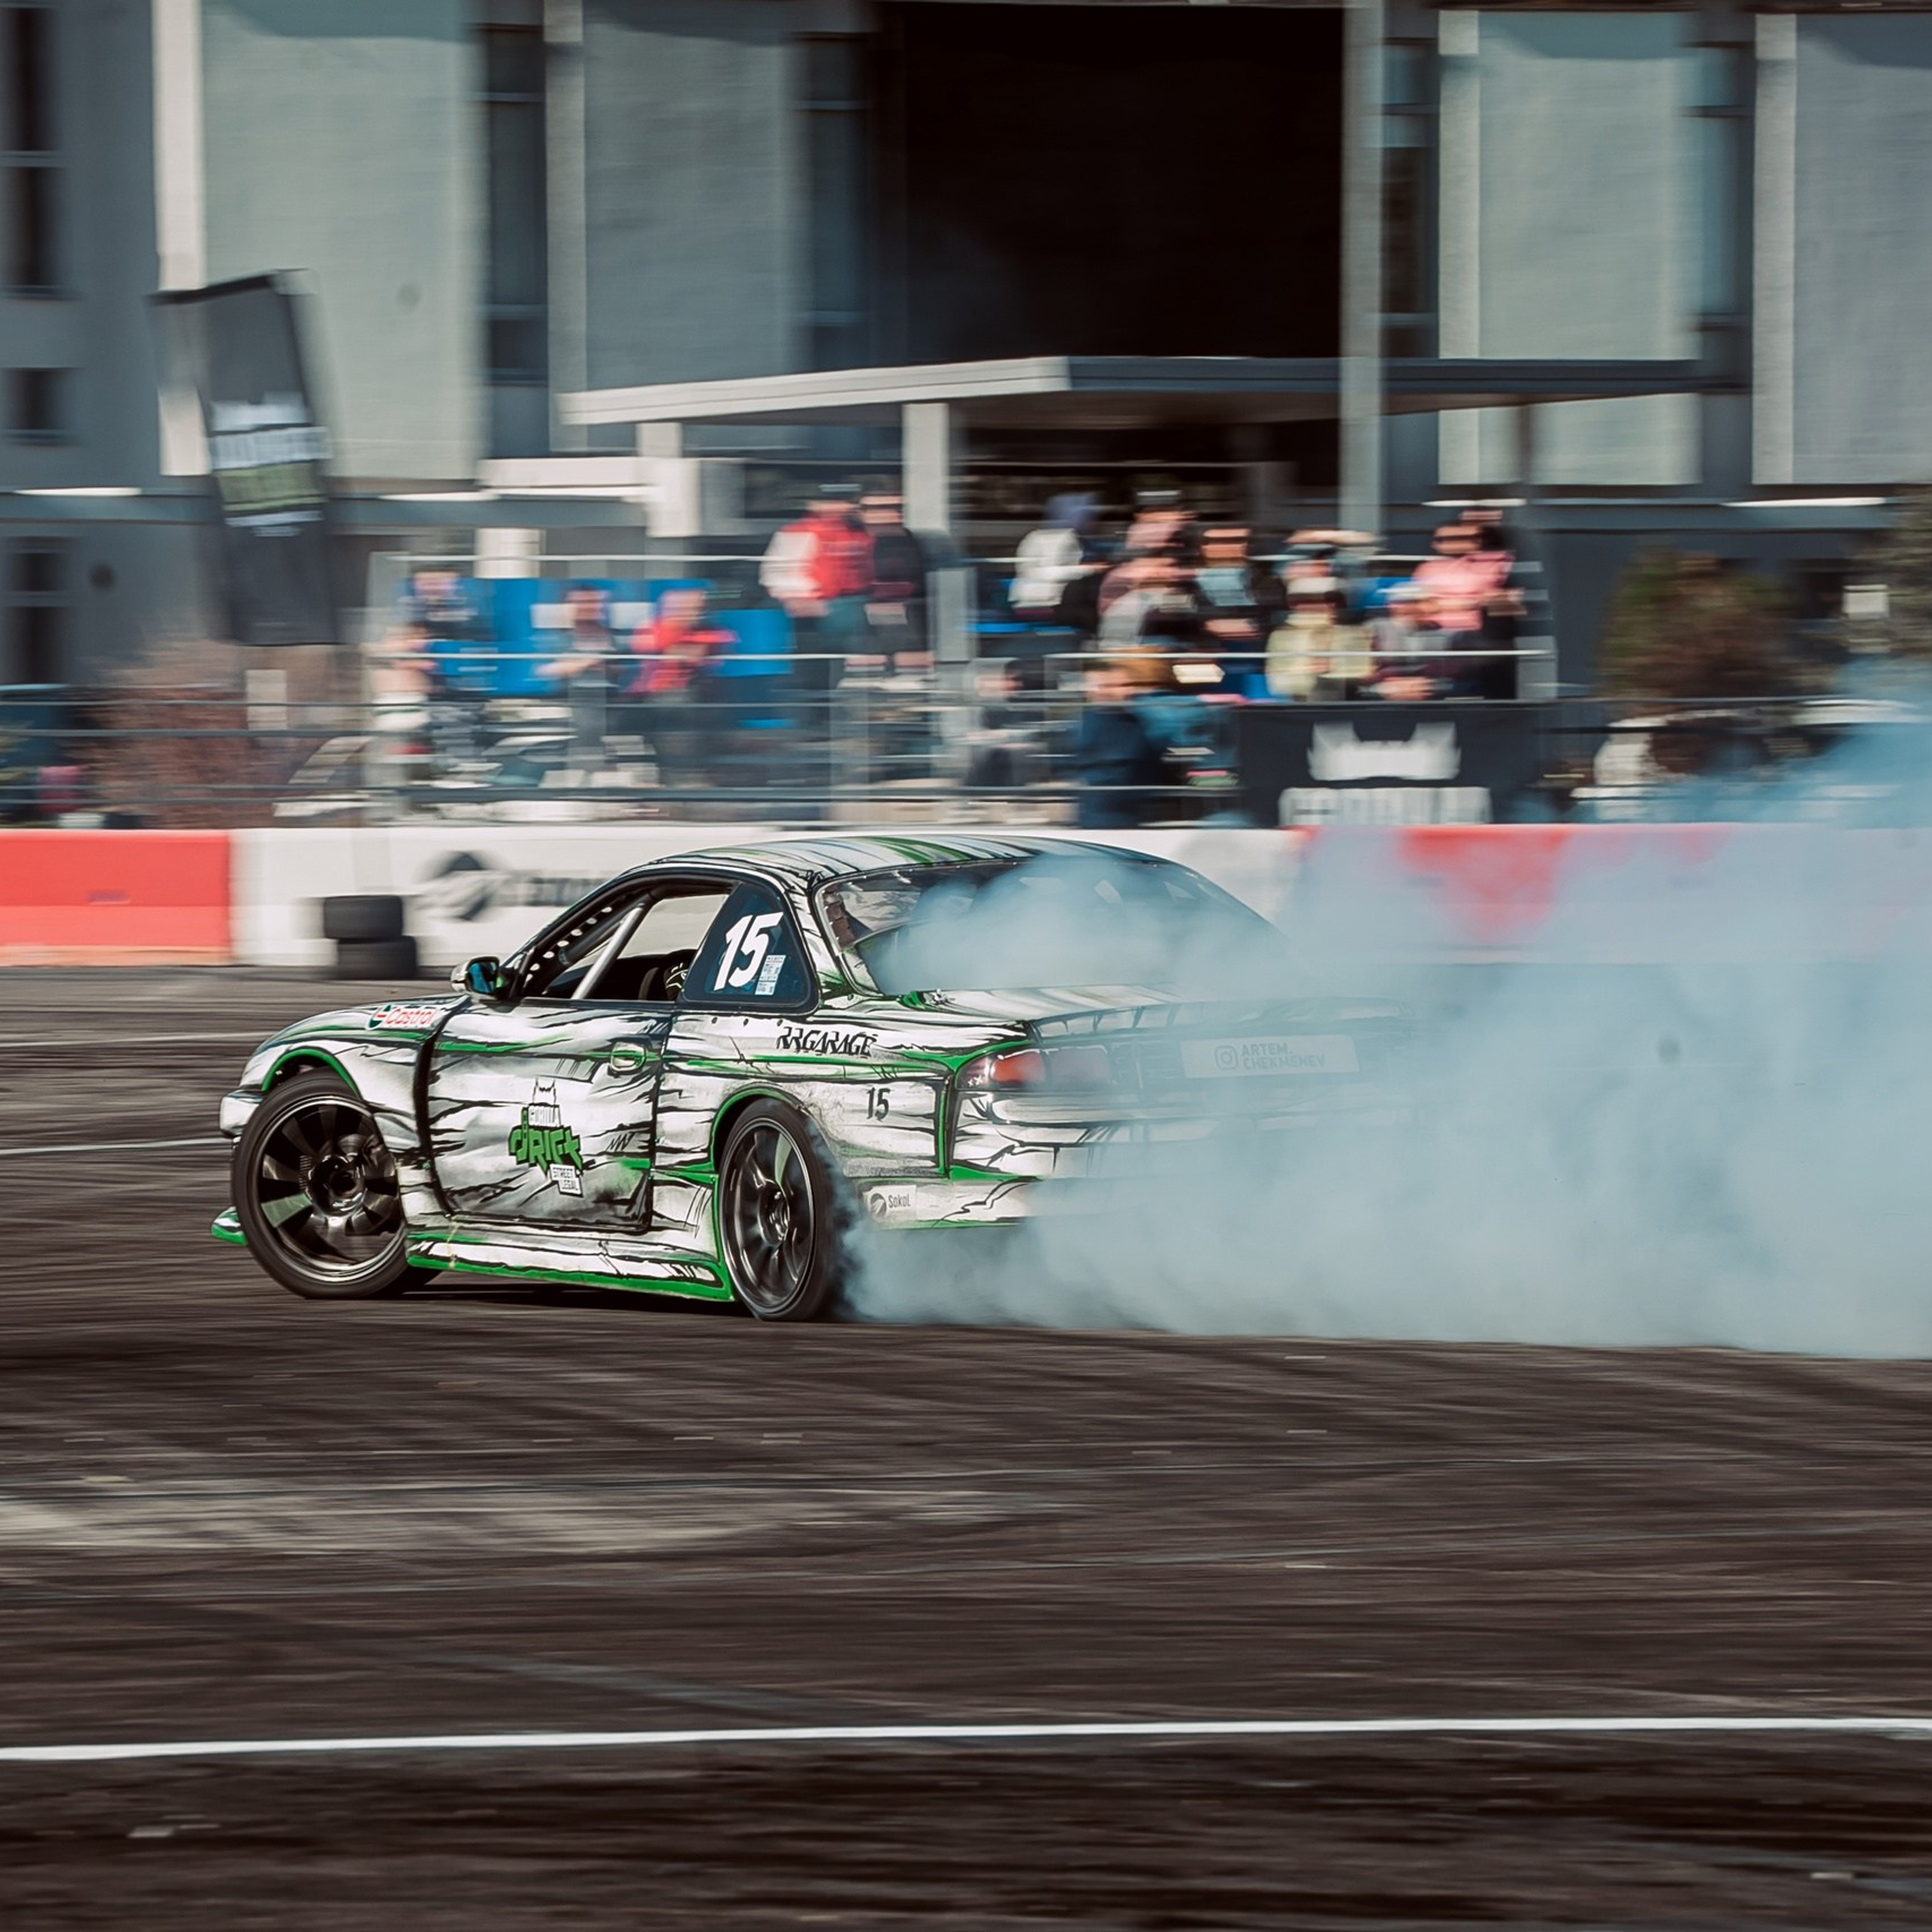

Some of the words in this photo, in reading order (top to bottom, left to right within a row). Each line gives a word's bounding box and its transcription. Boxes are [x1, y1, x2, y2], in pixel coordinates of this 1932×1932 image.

[713, 912, 784, 992] 15
[386, 1007, 438, 1025] Castrol
[777, 1026, 877, 1057] RRGARAGE
[866, 1088, 891, 1121] 15
